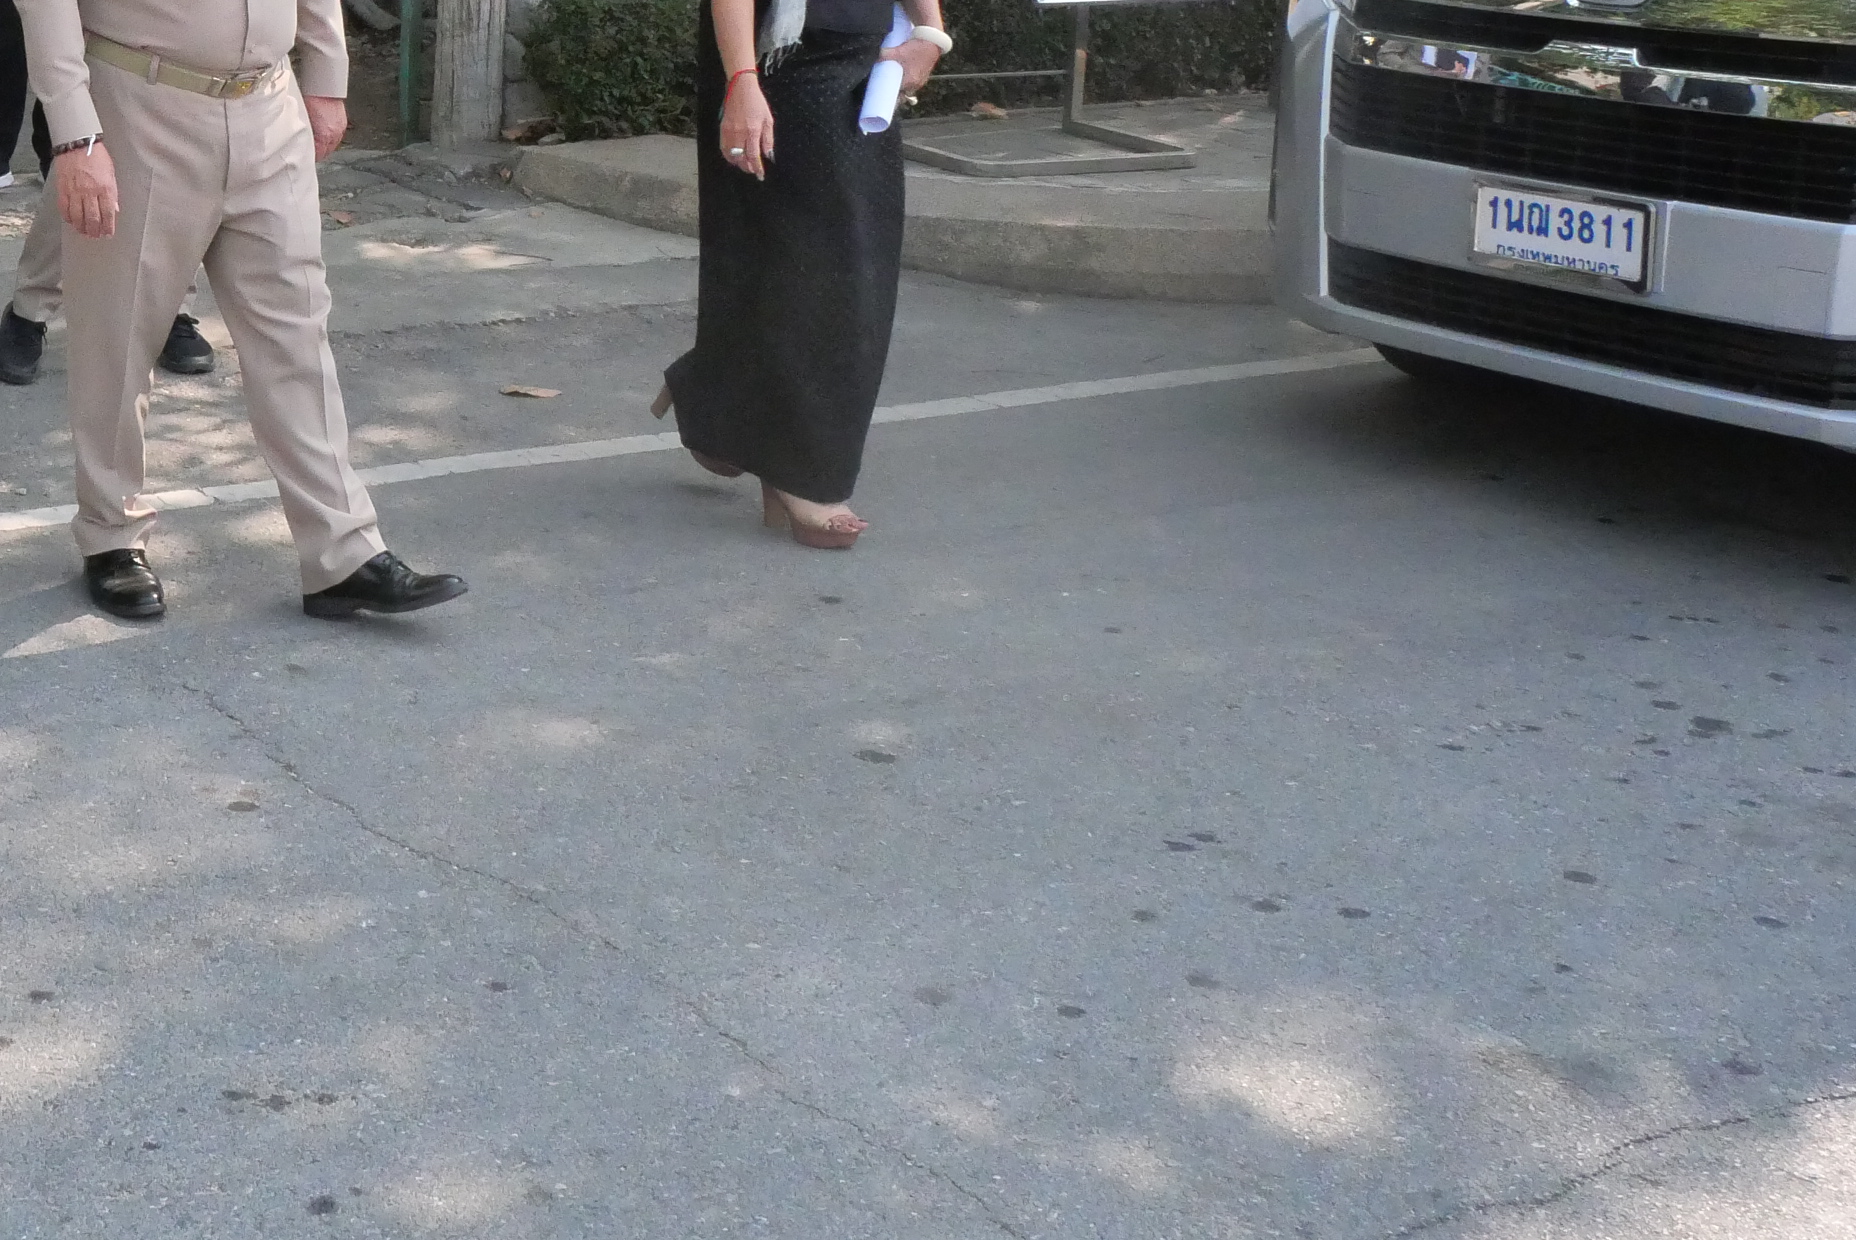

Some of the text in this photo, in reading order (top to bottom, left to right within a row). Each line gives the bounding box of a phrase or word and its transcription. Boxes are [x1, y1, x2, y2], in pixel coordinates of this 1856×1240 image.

[1489, 196, 1635, 252] 1นฌ 3811
[1496, 244, 1620, 276] กรงเทพมหานคร
